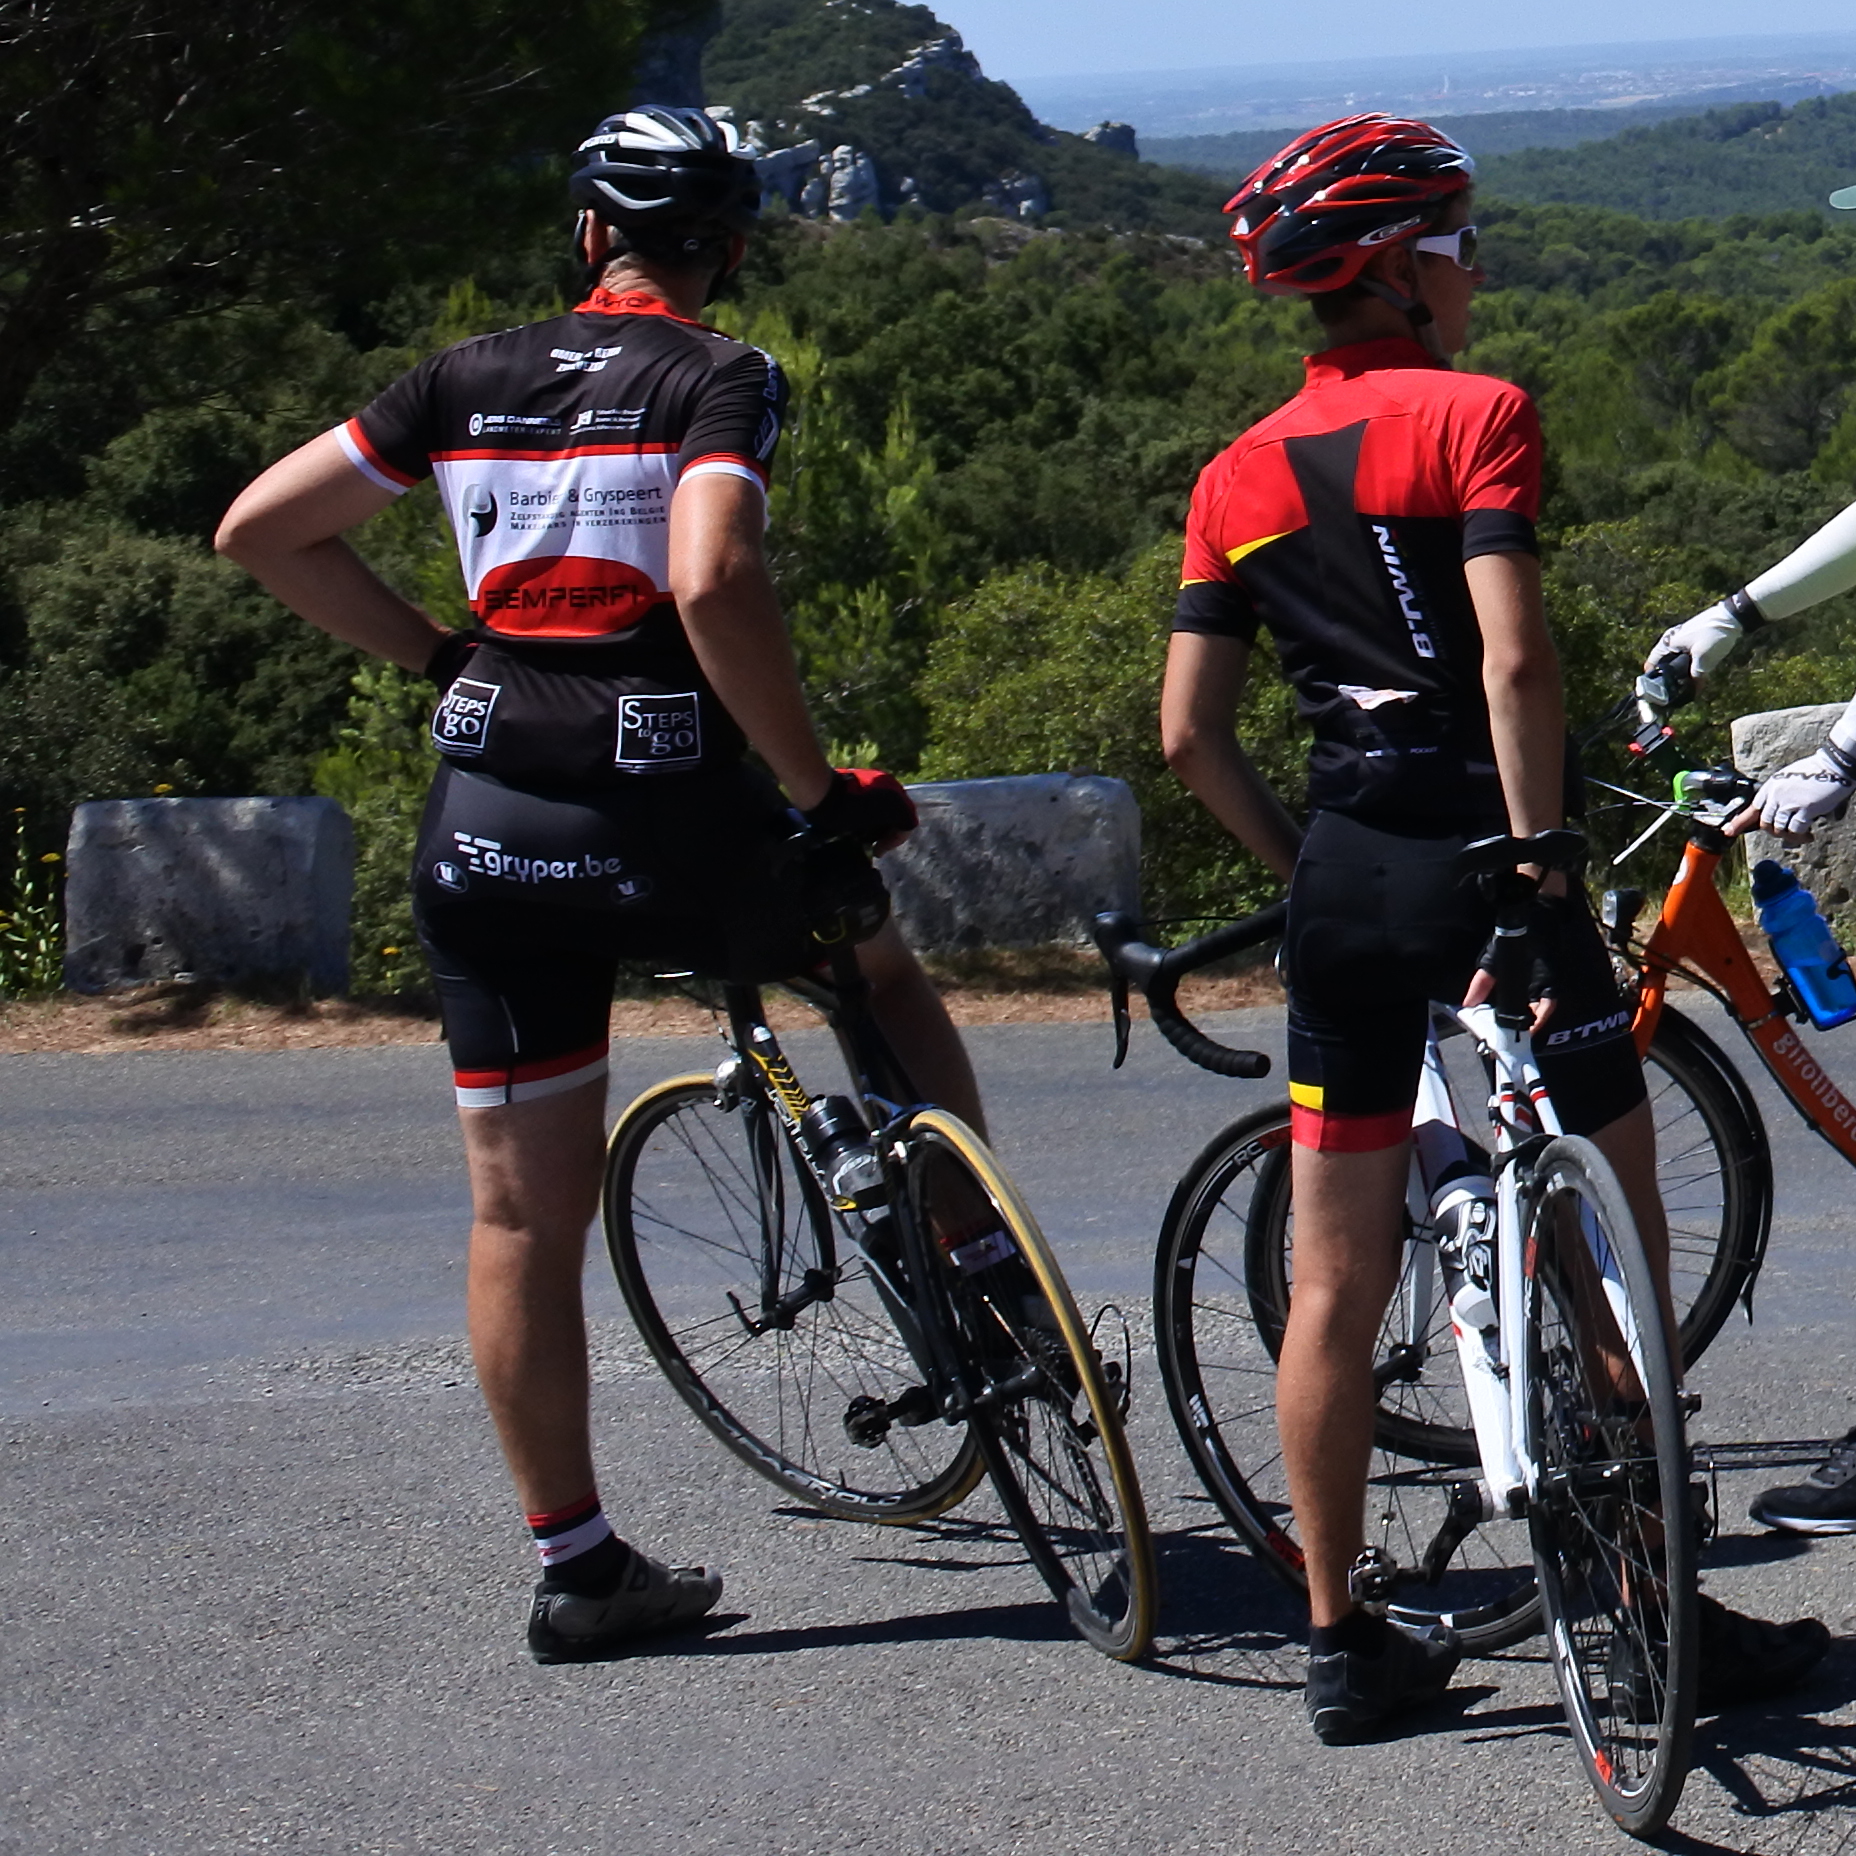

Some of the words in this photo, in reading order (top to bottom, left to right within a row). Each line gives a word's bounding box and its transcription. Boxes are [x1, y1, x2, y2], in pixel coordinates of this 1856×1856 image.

[567, 488, 580, 504] &
[583, 485, 664, 505] Gryspeert
[443, 713, 481, 737] go
[623, 700, 694, 730] STEPS
[637, 728, 652, 738] to
[650, 729, 695, 756] go
